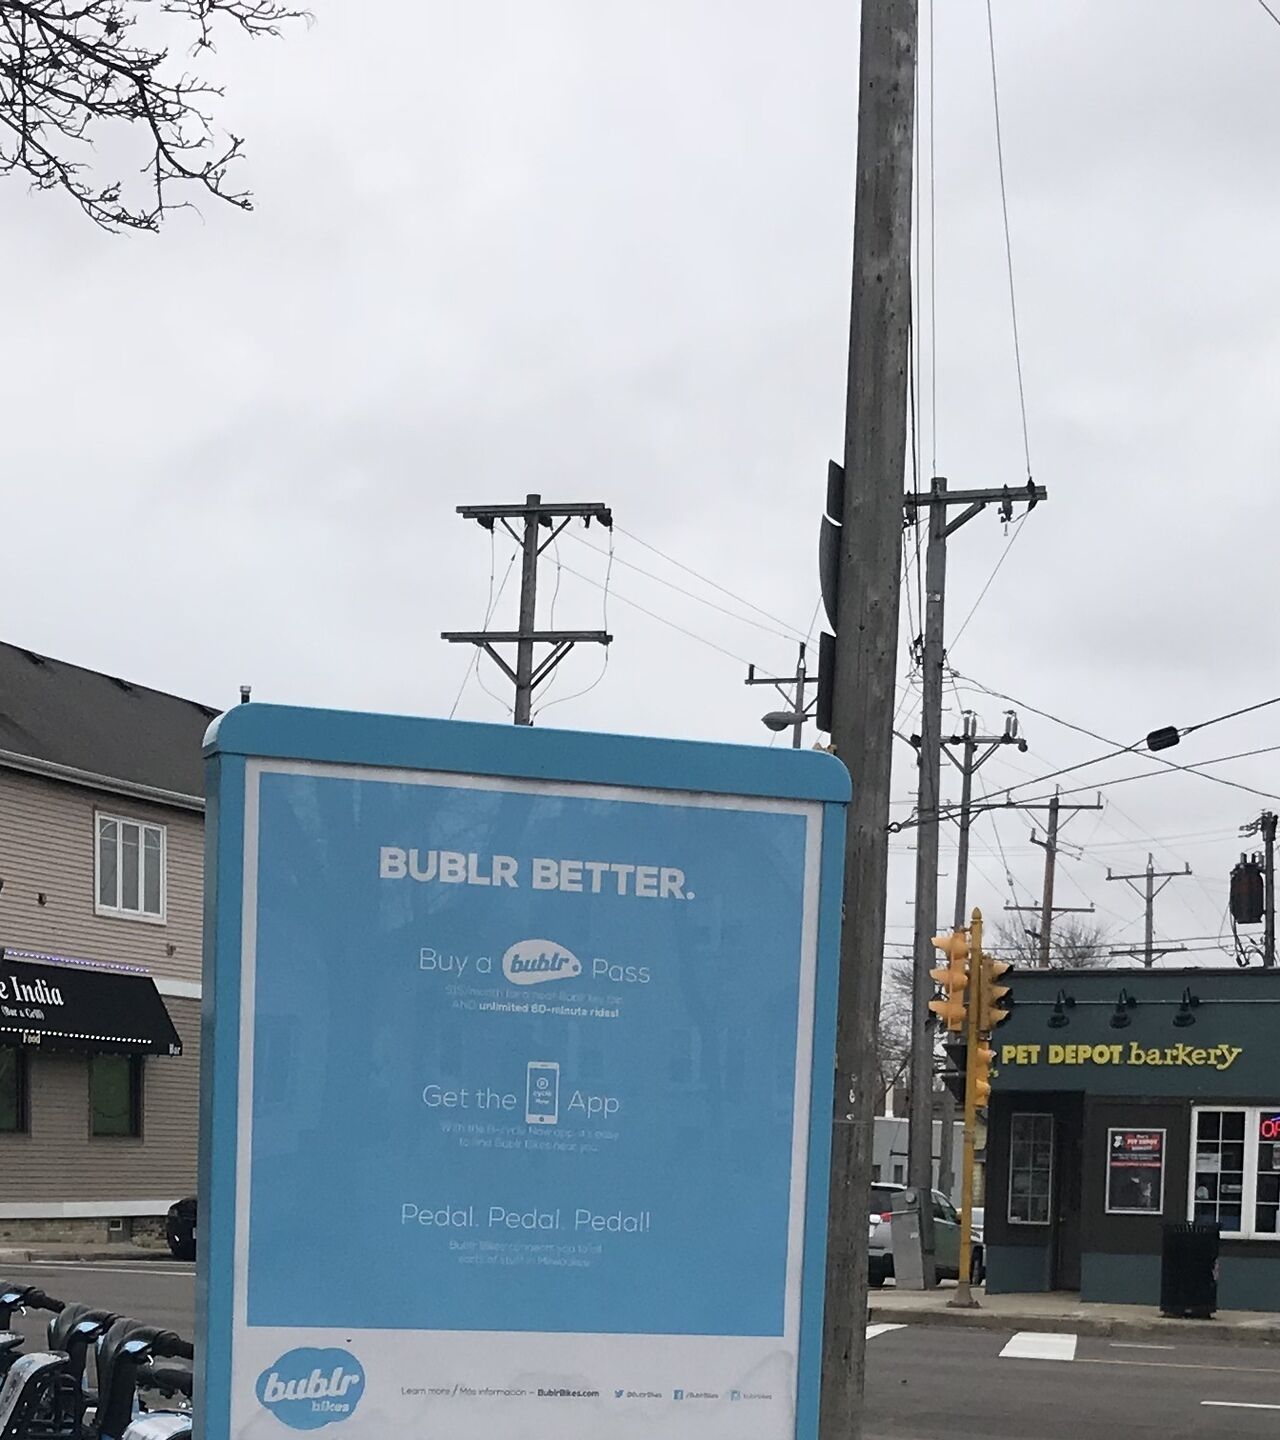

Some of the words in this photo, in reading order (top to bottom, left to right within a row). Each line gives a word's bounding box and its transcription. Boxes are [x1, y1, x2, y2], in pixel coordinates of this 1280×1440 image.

[379, 846, 519, 888] BUBLR
[532, 858, 695, 900] BETTER.
[419, 948, 468, 977] Buy
[476, 957, 491, 974] a
[592, 958, 651, 983] Pass
[9, 976, 64, 1006] India
[479, 1002, 528, 1013] unlimited
[1002, 1044, 1040, 1065] PET
[1048, 1044, 1123, 1066] DEPOT
[1127, 1042, 1242, 1071] barkery
[422, 1084, 470, 1108] Get
[475, 1088, 517, 1111] the
[567, 1090, 620, 1119] App
[401, 1203, 479, 1227] Pedal.
[488, 1206, 566, 1230] Pedal.
[575, 1208, 651, 1232] Pedal!
[264, 1366, 360, 1402] bublr
[537, 1388, 600, 1398] BublrBikes.com
[311, 1400, 350, 1412] bikes
